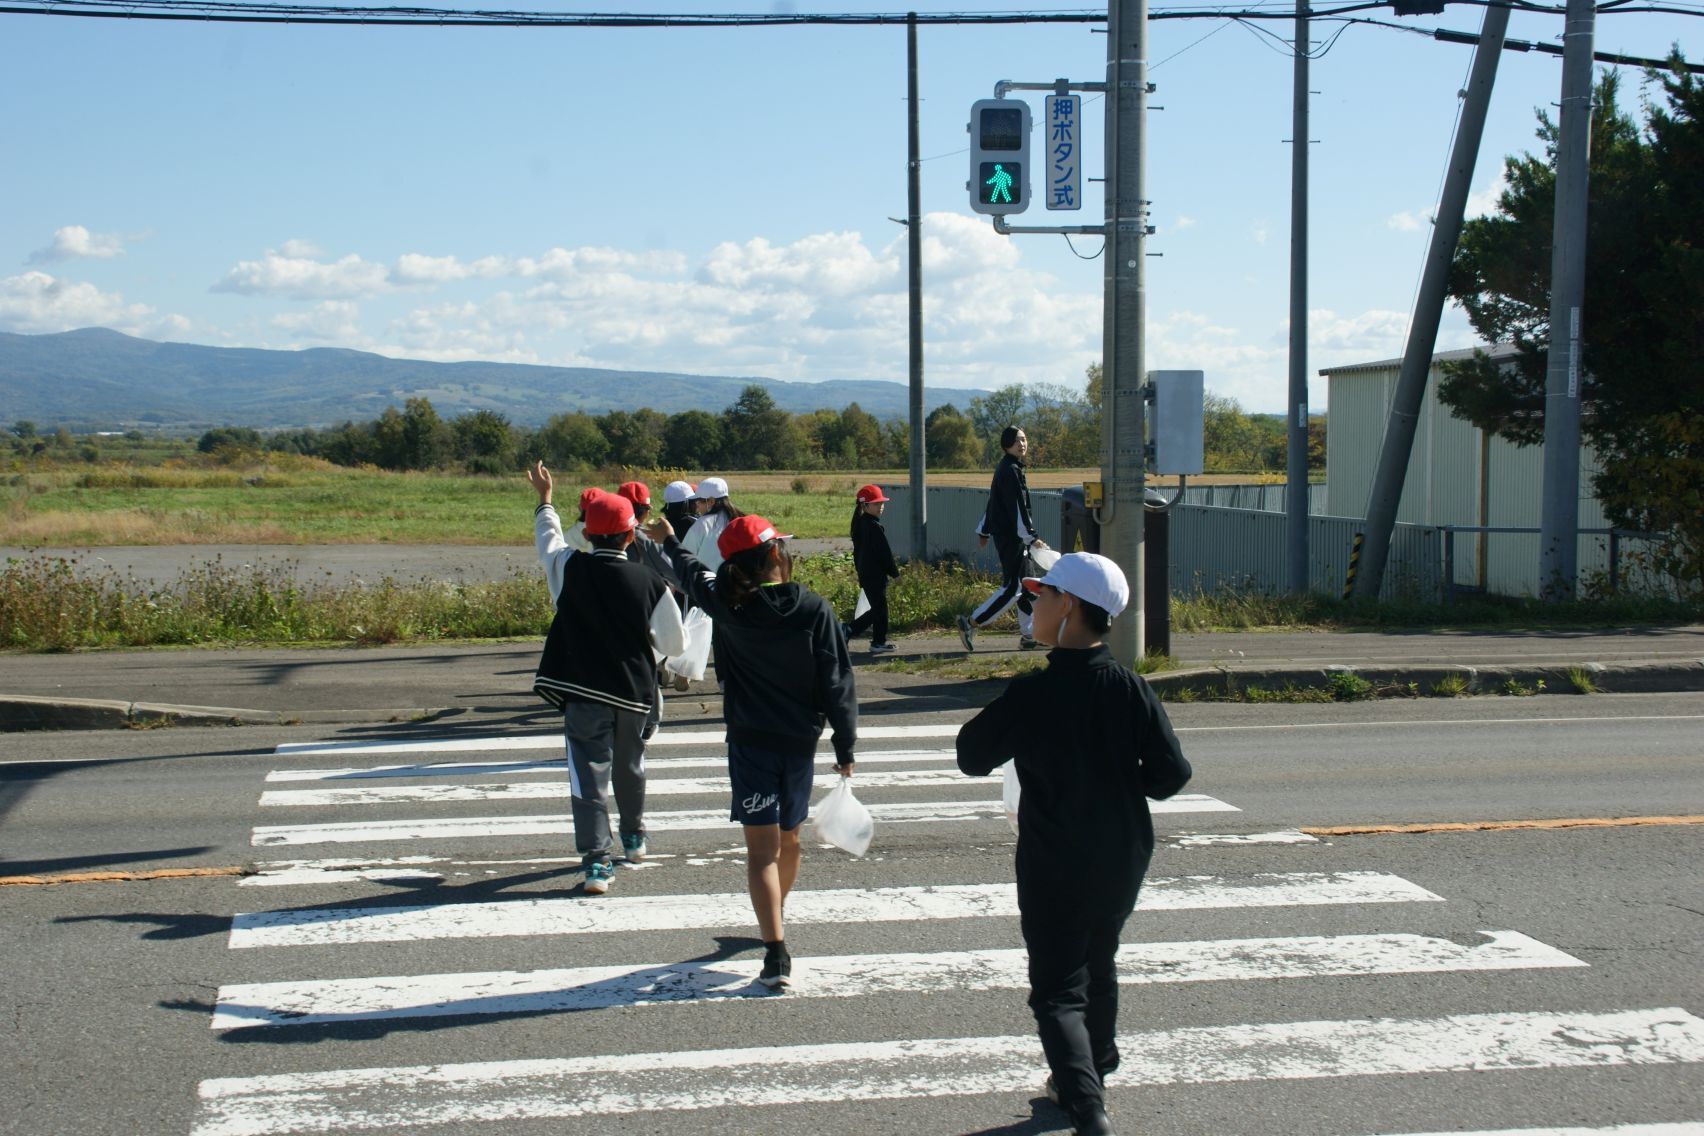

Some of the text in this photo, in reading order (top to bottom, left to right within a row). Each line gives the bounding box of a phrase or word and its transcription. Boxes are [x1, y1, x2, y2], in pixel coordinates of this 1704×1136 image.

[1053, 99, 1074, 206] 押ボタン式
